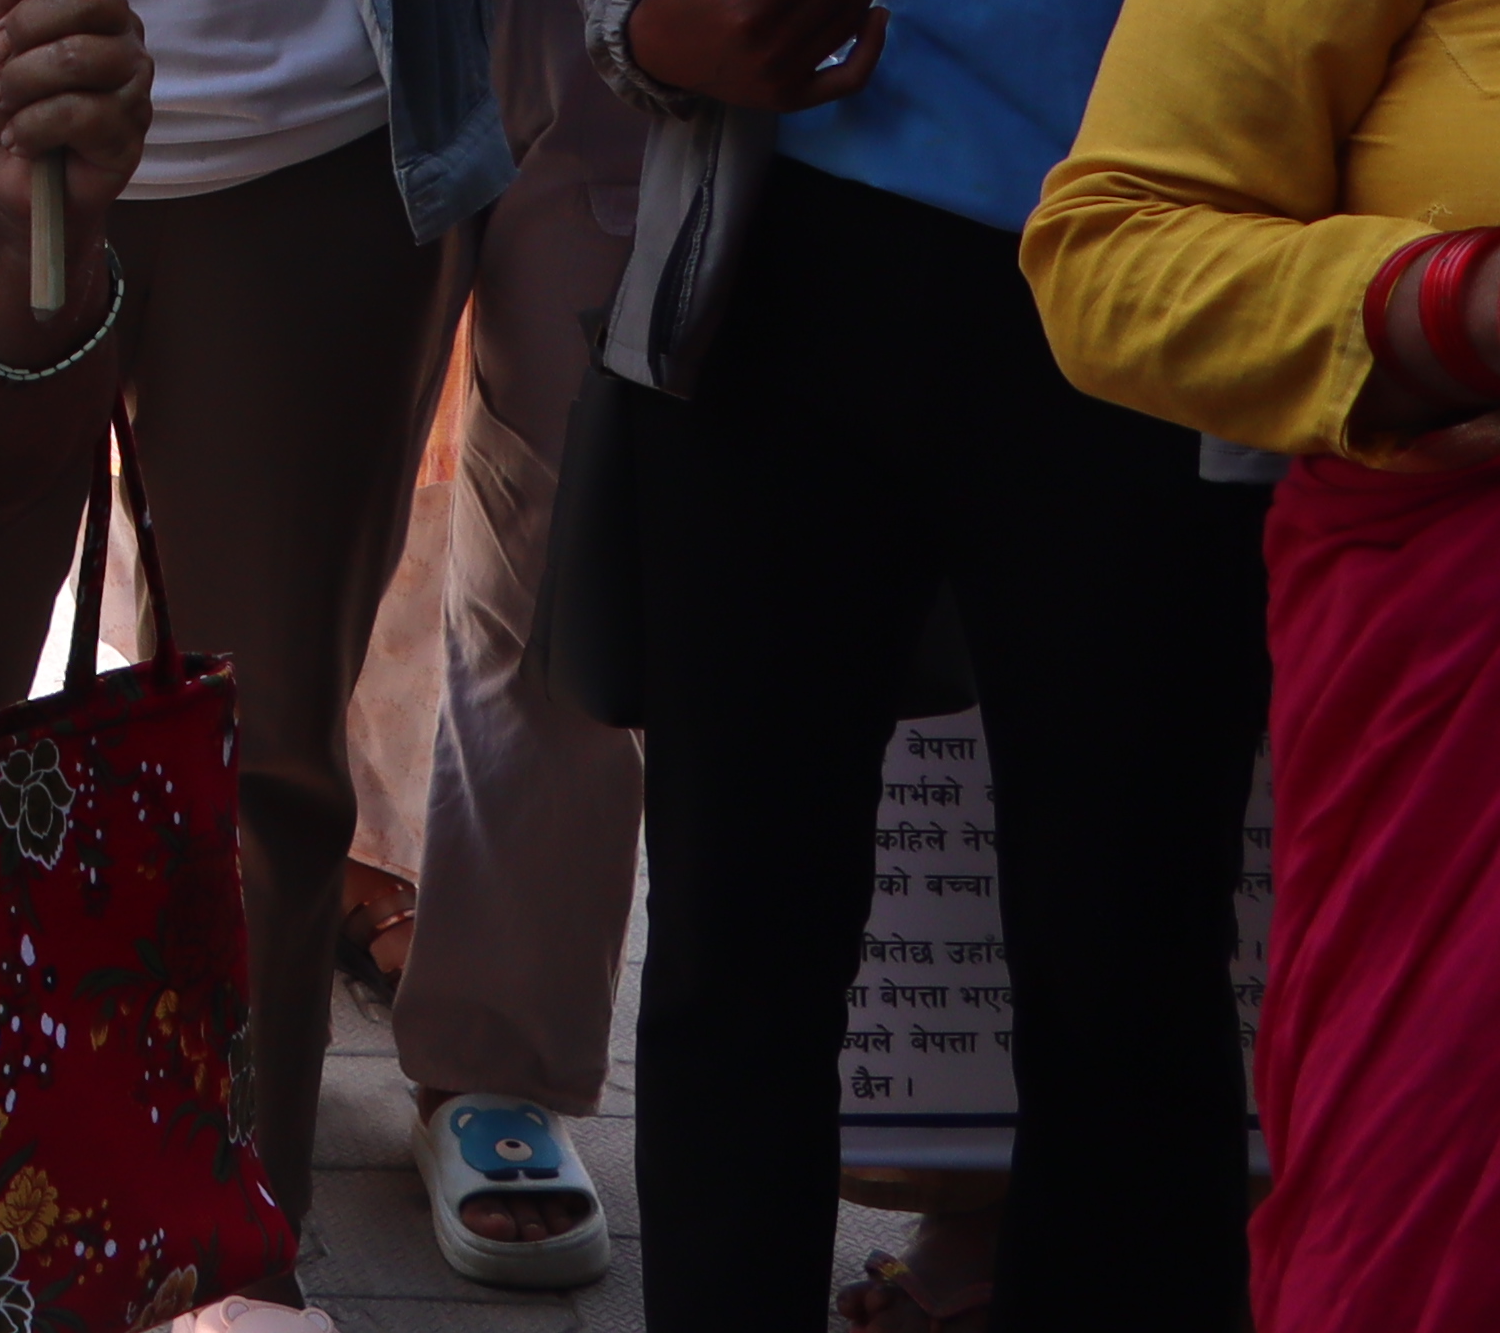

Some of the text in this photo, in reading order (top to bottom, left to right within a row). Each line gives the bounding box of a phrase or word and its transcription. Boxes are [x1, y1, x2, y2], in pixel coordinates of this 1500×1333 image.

[906, 730, 976, 760] बेपत्ता
[885, 776, 962, 806] गर्भको
[875, 822, 946, 853] कहिले
[962, 821, 998, 853] नेप
[926, 873, 993, 896] बच्चा
[880, 979, 947, 1009] बेपत्ता
[910, 1024, 977, 1053] बेपत्ता
[851, 1066, 892, 1099] छैन
